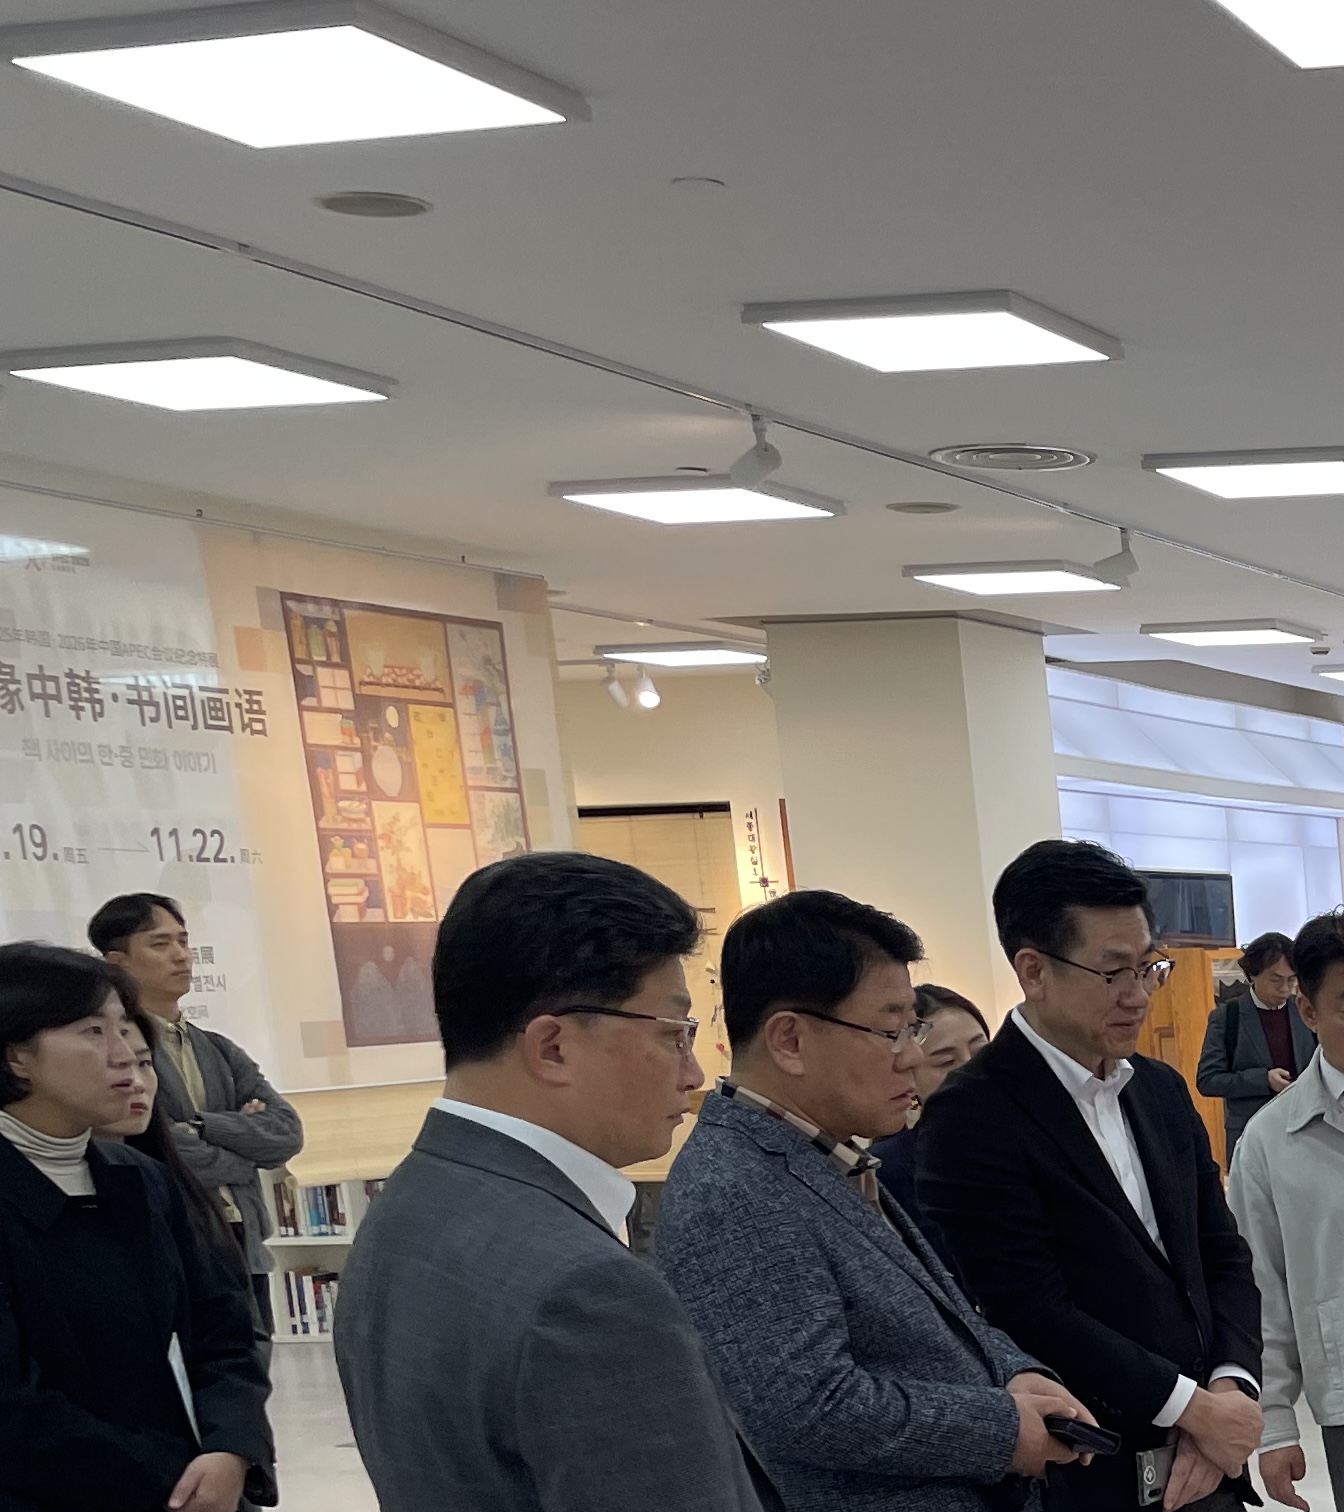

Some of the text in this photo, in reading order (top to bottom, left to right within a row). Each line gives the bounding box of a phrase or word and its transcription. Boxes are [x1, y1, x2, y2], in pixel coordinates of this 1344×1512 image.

[46, 739, 95, 765] 사이의
[138, 747, 168, 771] 민화
[172, 750, 217, 774] 이야기
